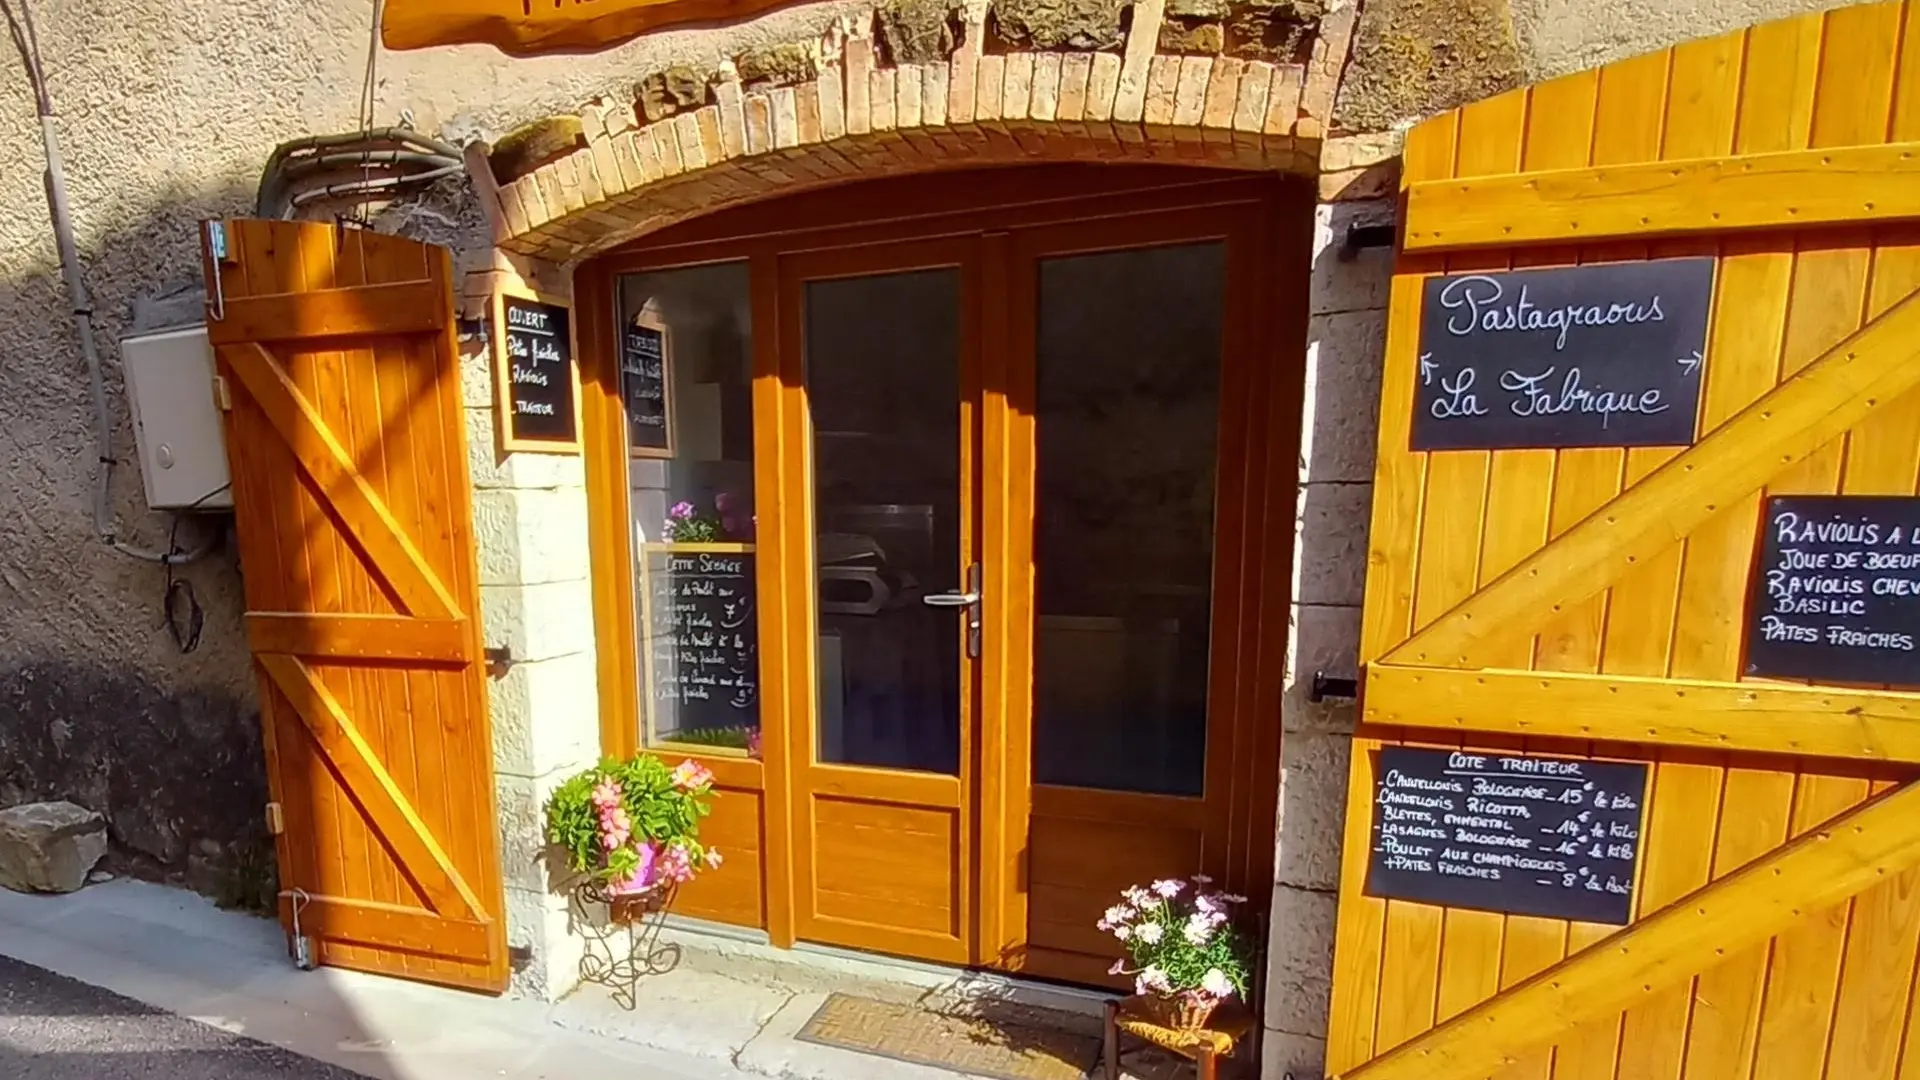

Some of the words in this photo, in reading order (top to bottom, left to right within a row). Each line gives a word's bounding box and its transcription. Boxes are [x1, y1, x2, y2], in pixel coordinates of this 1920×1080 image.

[1440, 275, 1665, 350] Pastagraous
[1431, 367, 1489, 419] La
[1500, 366, 1670, 430] Fabrique
[1774, 512, 1880, 545] RAVIOLIS
[1885, 527, 1903, 545] A
[1778, 549, 1830, 571] JOUE
[1830, 551, 1863, 569] DE
[1498, 758, 1583, 775] TRAITEUR
